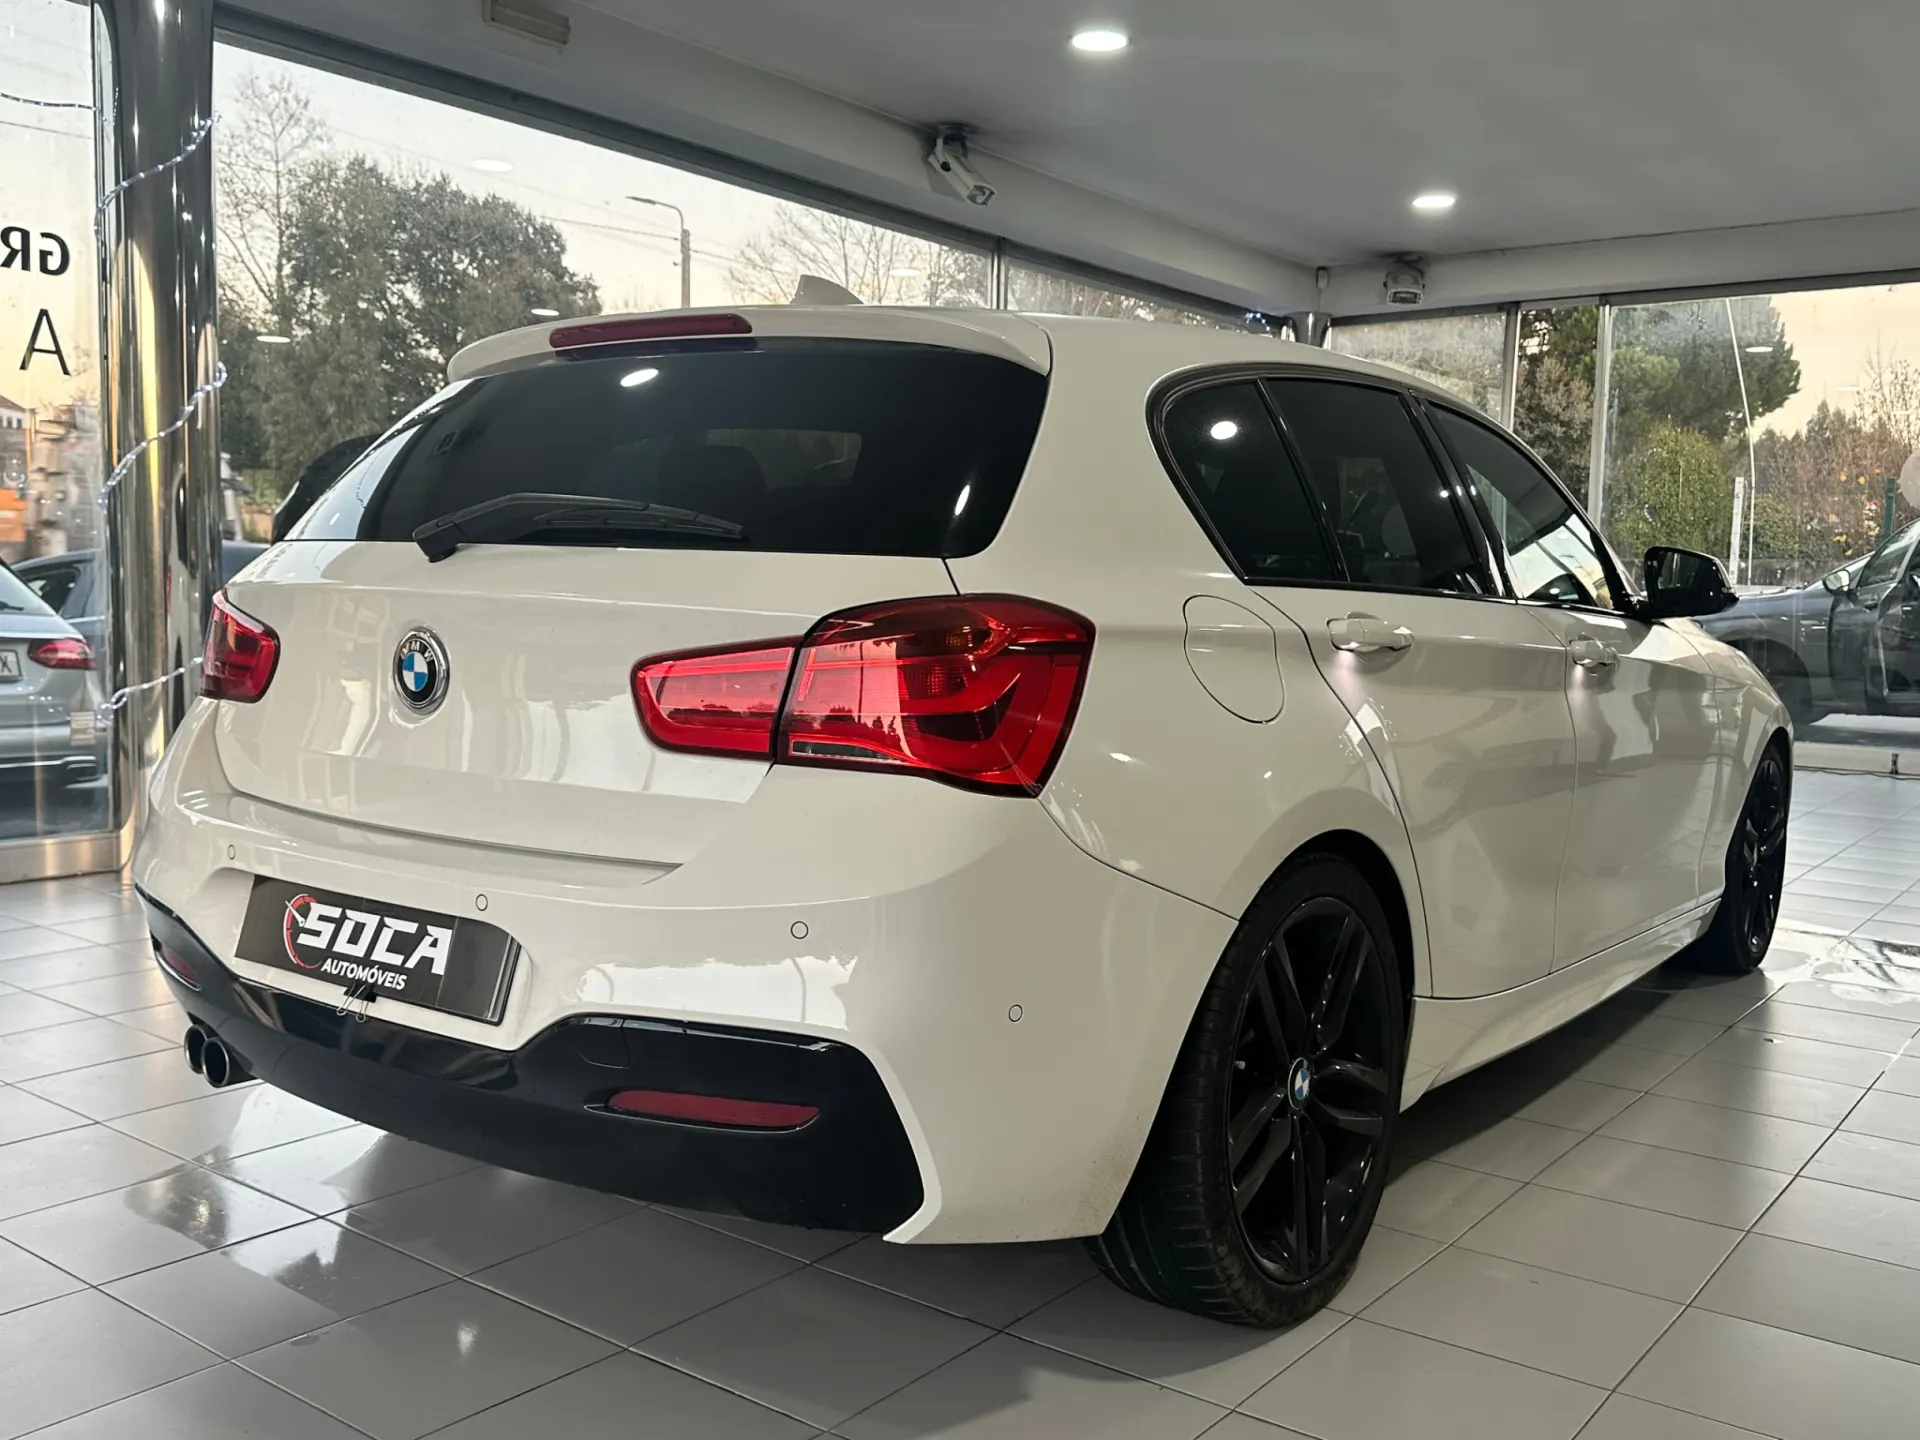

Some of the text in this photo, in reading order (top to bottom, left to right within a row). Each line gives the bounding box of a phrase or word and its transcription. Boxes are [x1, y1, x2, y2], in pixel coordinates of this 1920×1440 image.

[400, 640, 435, 662] BMW
[296, 902, 453, 976] SOCA
[320, 957, 407, 990] AUTOMÓVEIS
